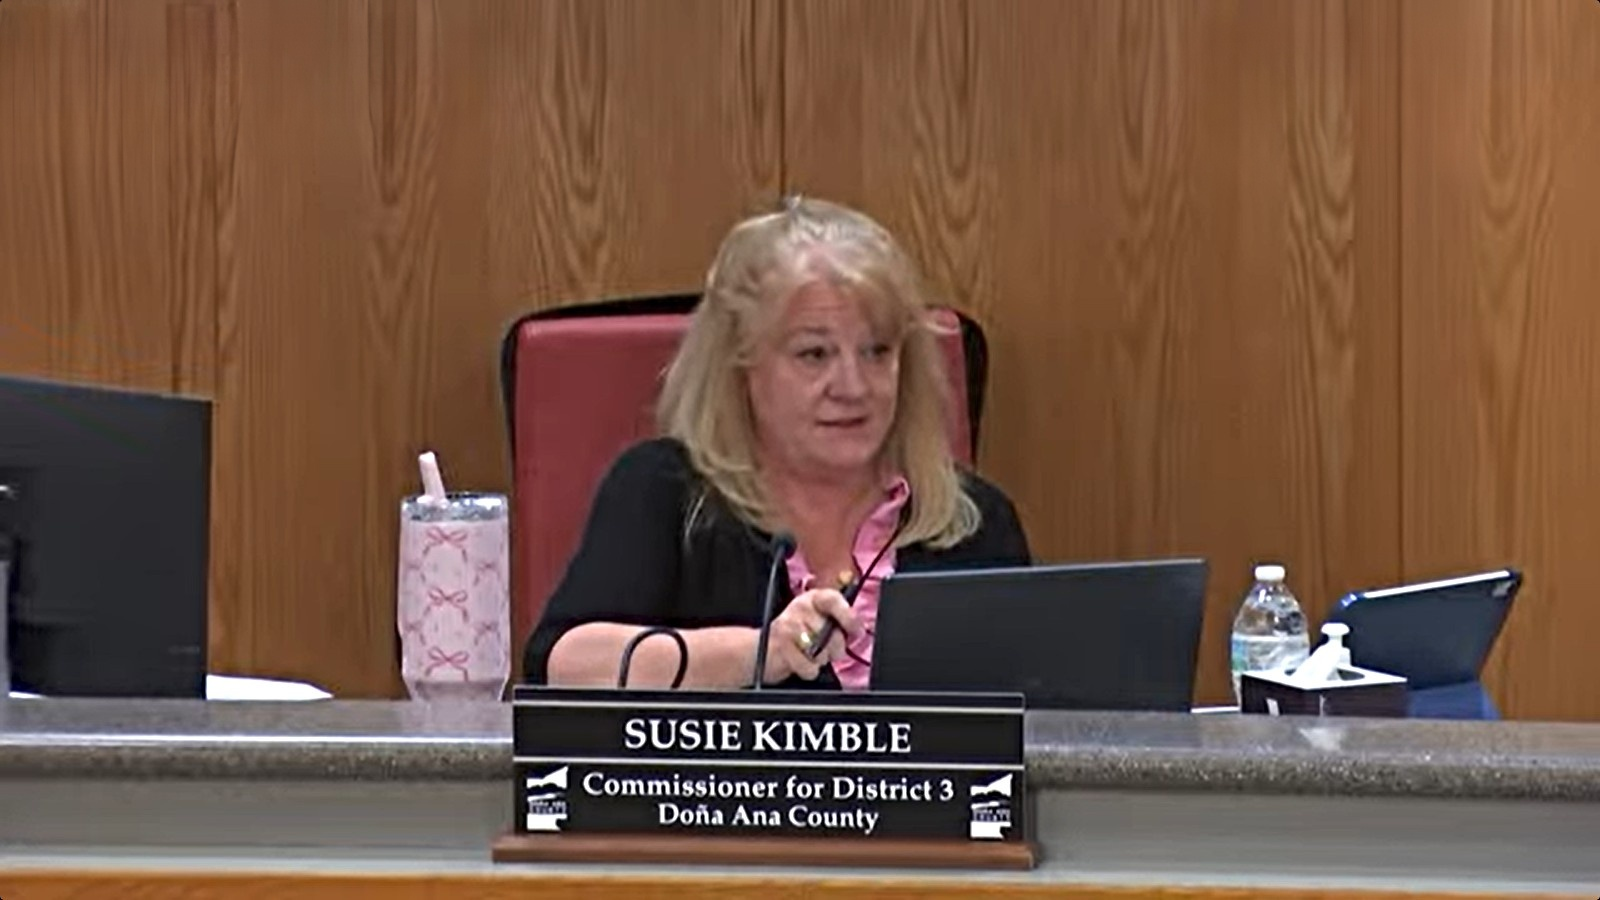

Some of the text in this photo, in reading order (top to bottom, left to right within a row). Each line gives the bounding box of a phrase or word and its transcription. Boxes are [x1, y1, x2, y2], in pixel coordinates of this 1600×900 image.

[625, 719, 911, 753] SUSIE KIMBLE
[583, 772, 953, 801] Commissioner for District 3
[659, 803, 878, 834] Doña Ana County
